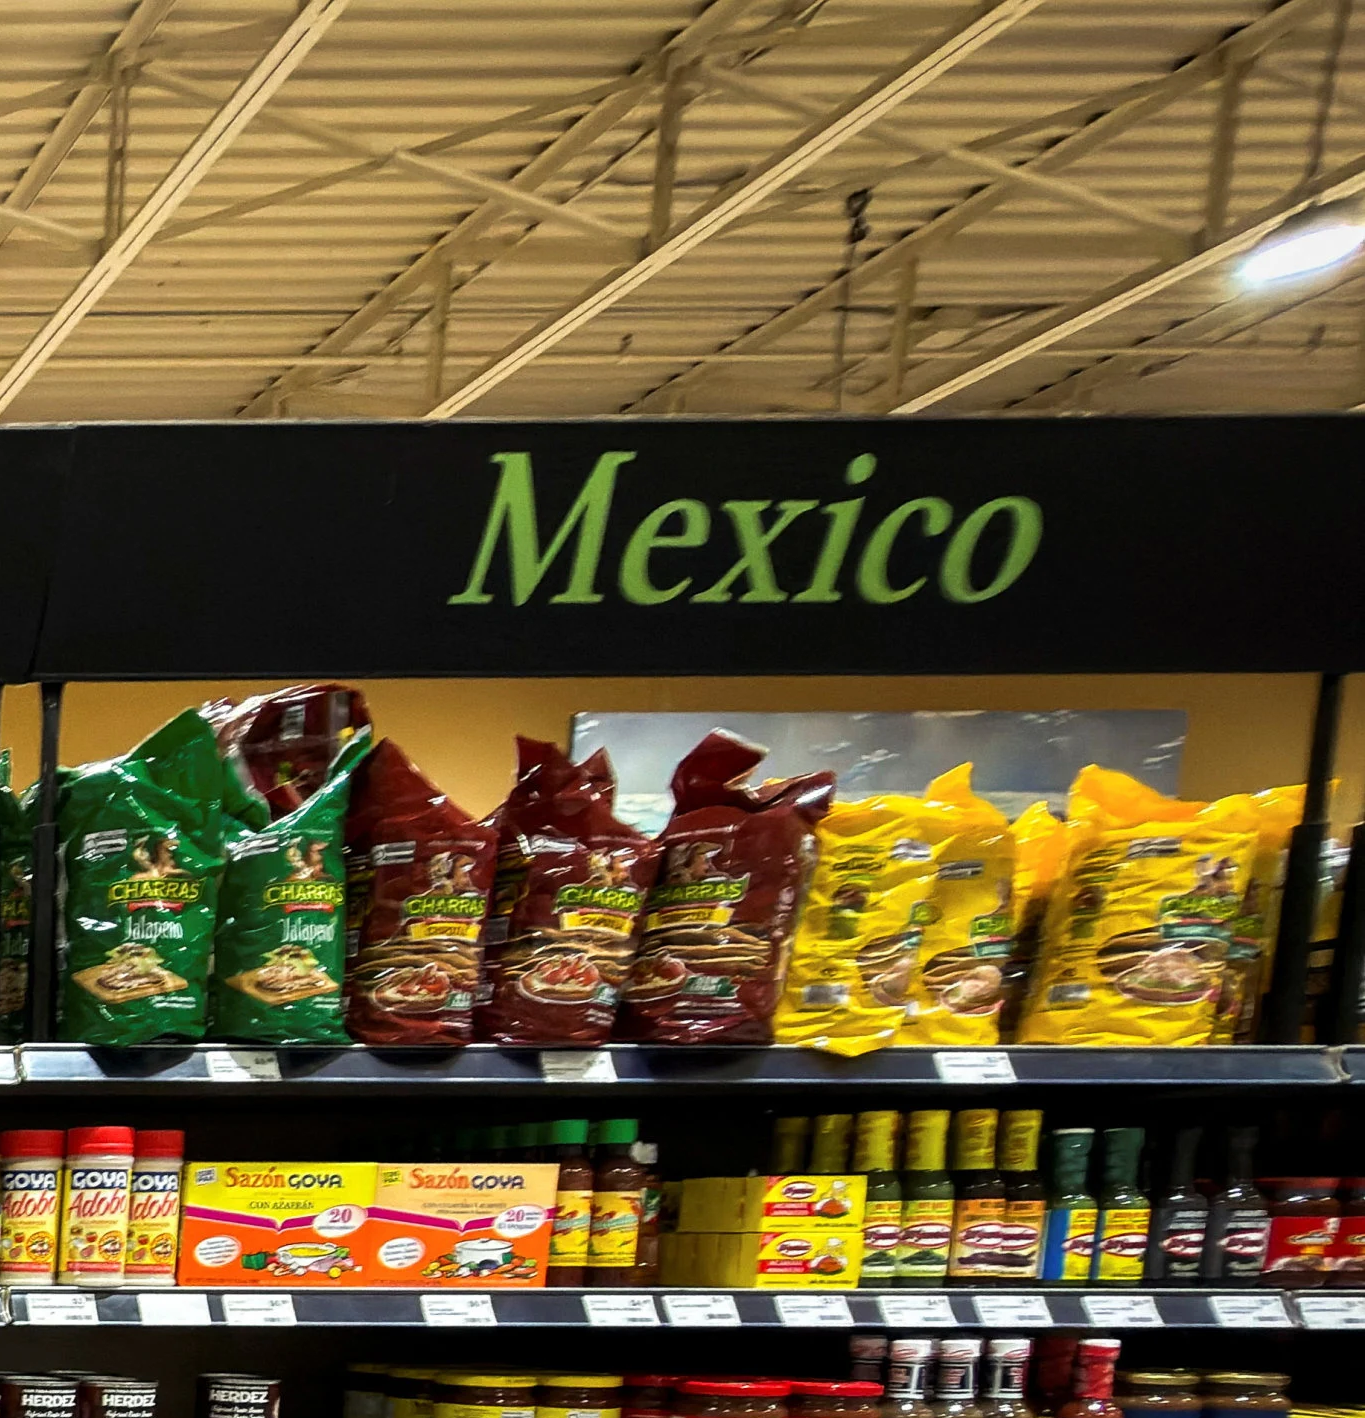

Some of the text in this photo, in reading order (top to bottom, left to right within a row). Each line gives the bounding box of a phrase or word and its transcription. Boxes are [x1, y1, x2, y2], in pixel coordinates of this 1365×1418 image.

[448, 451, 1041, 606] Mexico
[111, 882, 200, 900] CHARRAS
[267, 884, 343, 902] CHARRAS
[409, 899, 485, 915] CHARRAS
[3, 1173, 56, 1189] GOYA
[72, 1171, 127, 1188] GOYA
[225, 1167, 342, 1189] Sazón GOYA
[410, 1167, 525, 1190] Sazón GOYA
[329, 1209, 352, 1223] 20
[507, 1210, 525, 1222] 20
[22, 1394, 76, 1407] HERDEZ
[102, 1394, 155, 1407] HERDEZ
[210, 1390, 268, 1402] HERDEZ
